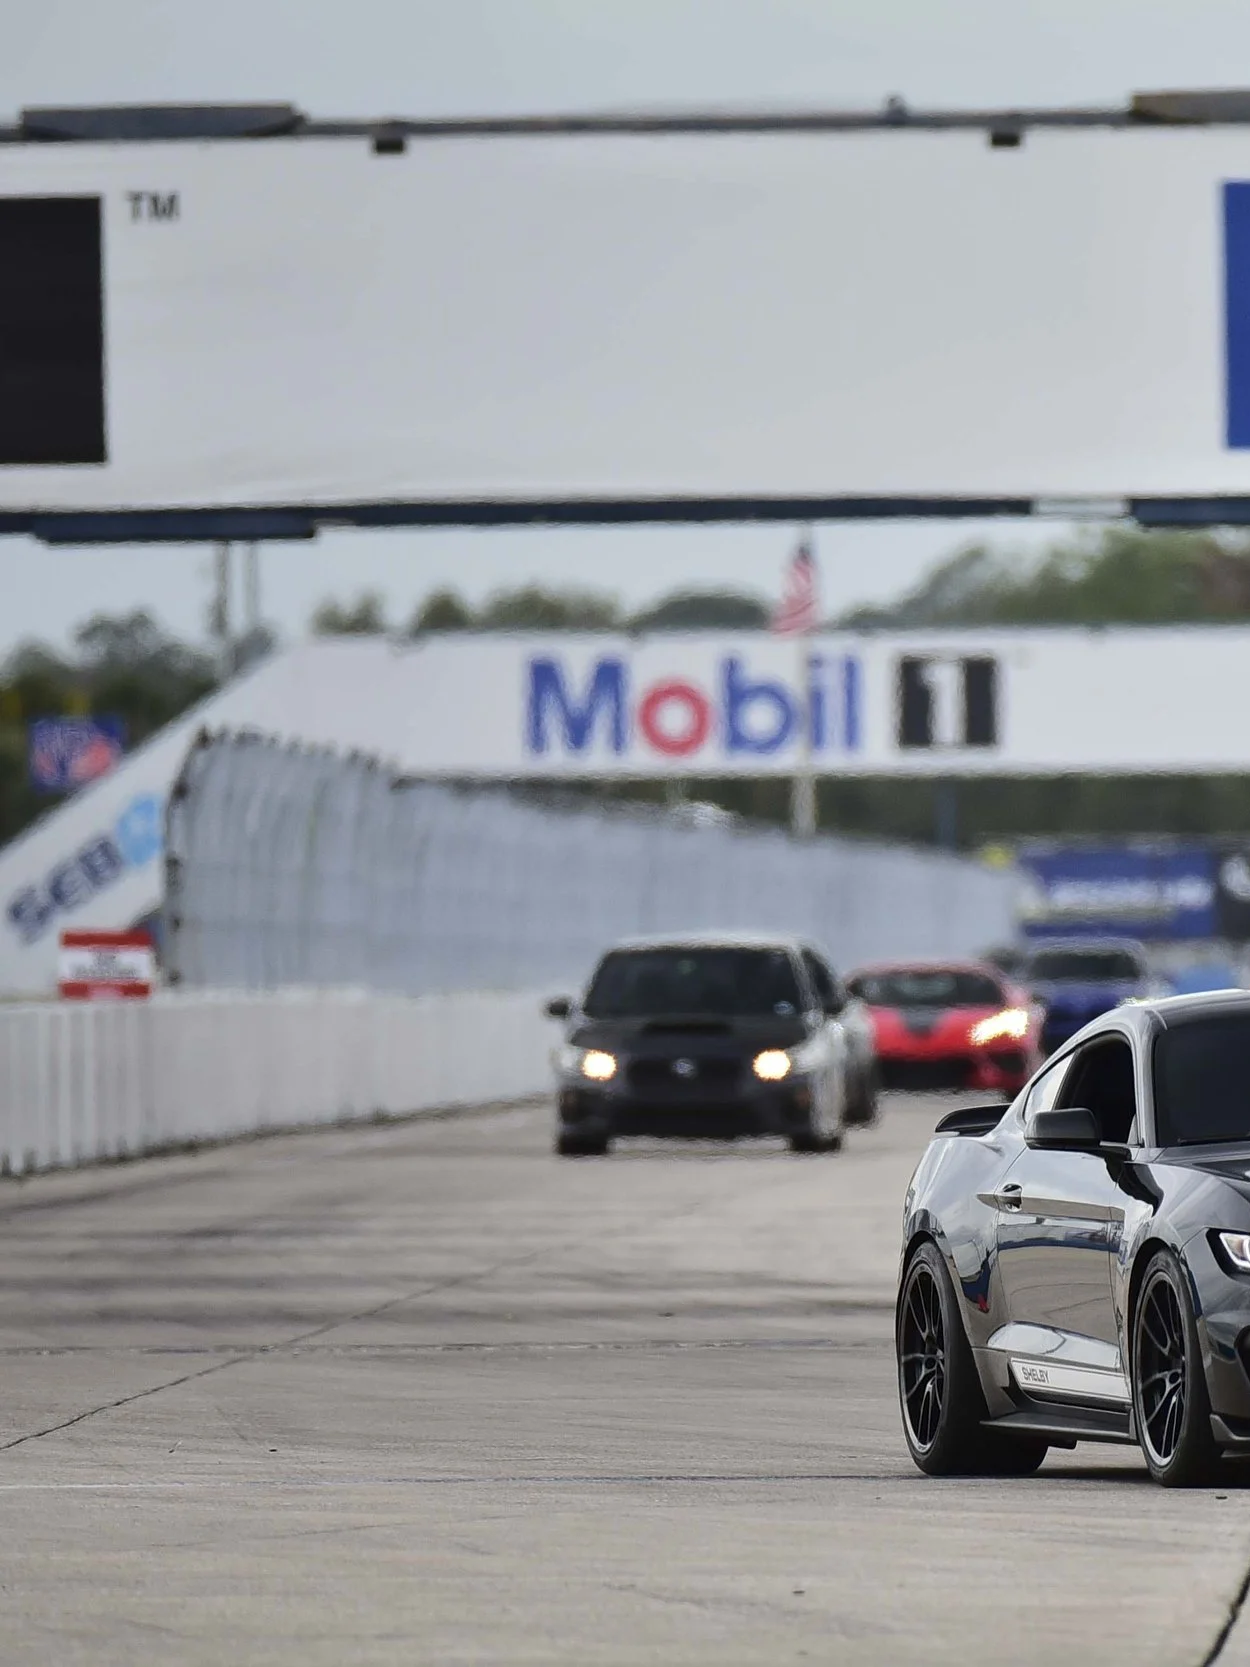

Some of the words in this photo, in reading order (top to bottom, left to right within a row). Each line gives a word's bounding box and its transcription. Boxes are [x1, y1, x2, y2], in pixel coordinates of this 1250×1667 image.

[125, 189, 179, 221] TM
[526, 652, 862, 756] Mobil
[920, 657, 966, 748] 1
[1021, 1366, 1050, 1384] SHELBY
